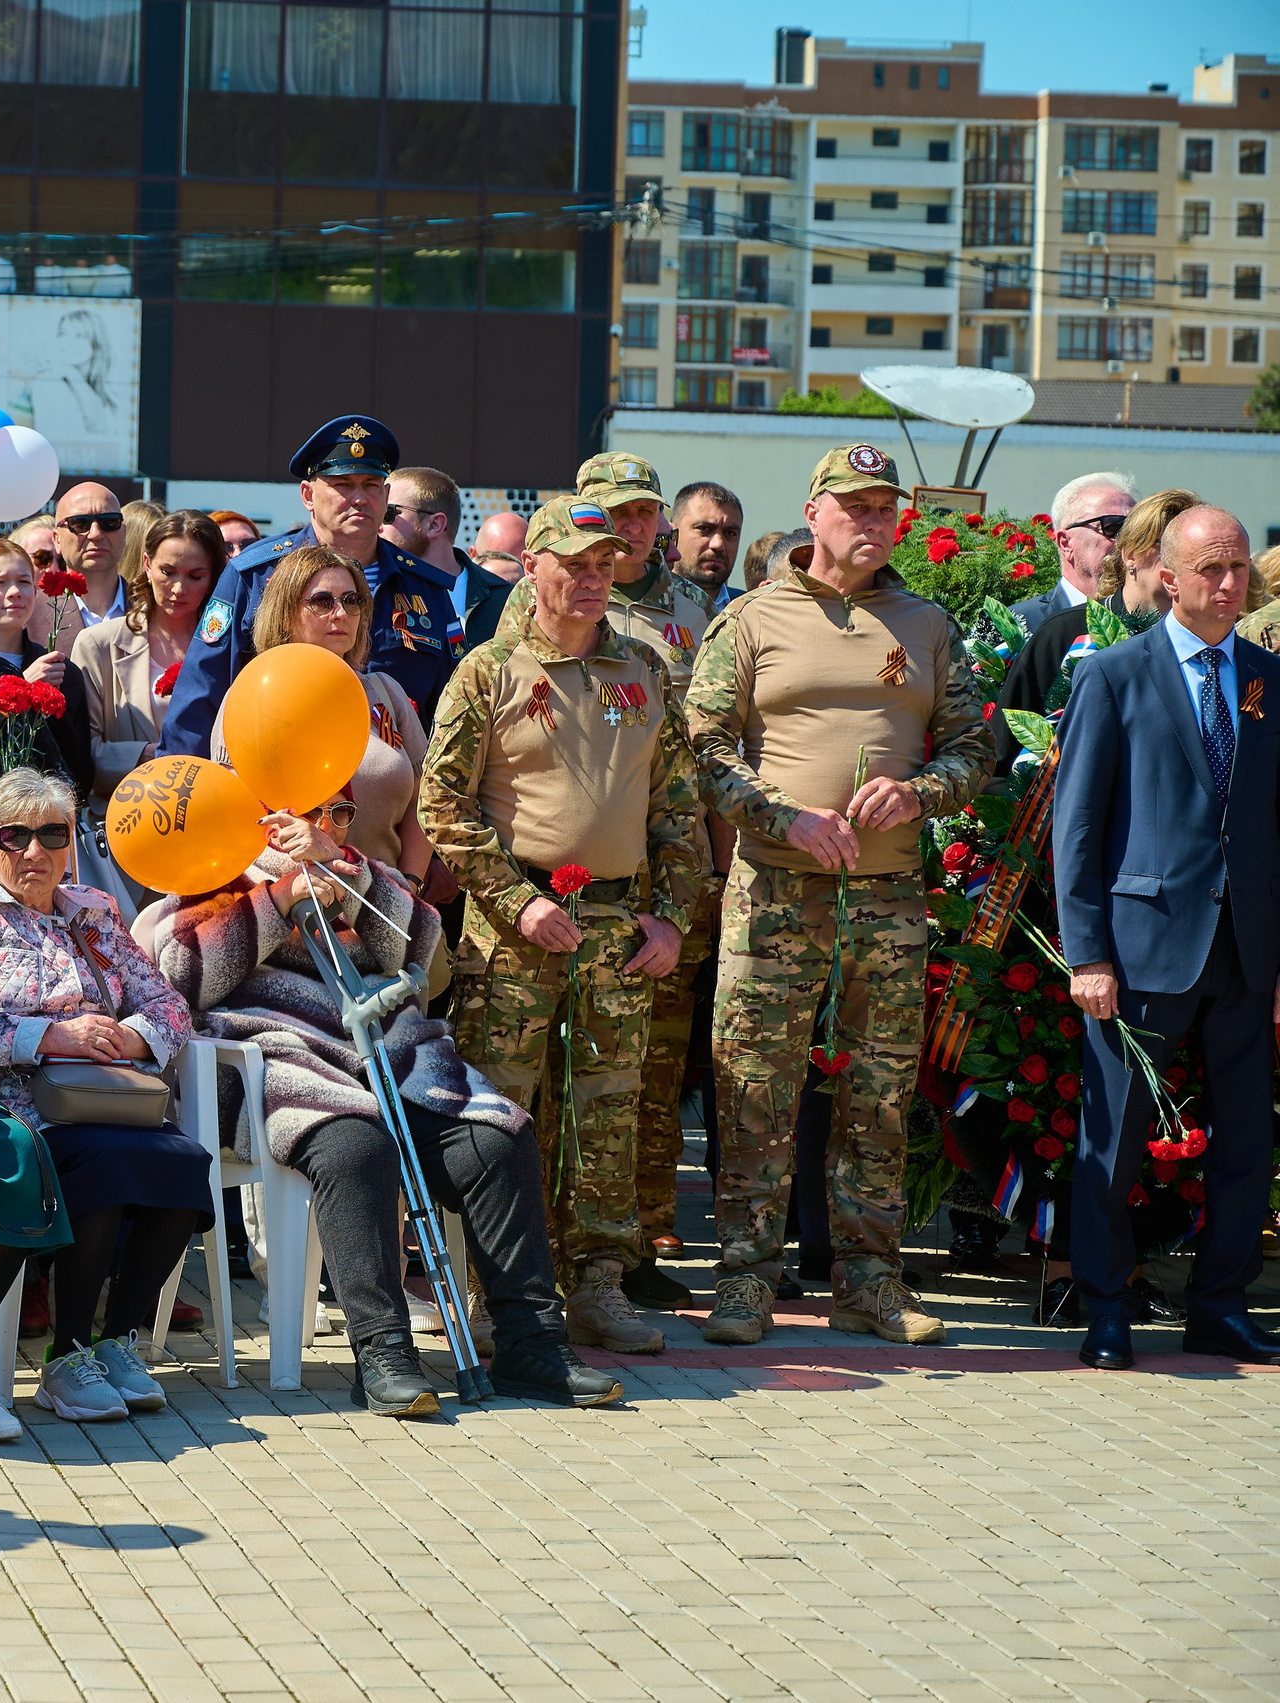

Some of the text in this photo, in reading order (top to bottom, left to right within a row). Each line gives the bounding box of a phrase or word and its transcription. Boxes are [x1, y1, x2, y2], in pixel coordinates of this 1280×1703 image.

[622, 462, 640, 479] Z
[114, 779, 146, 804] 9
[176, 803, 186, 826] 1941
